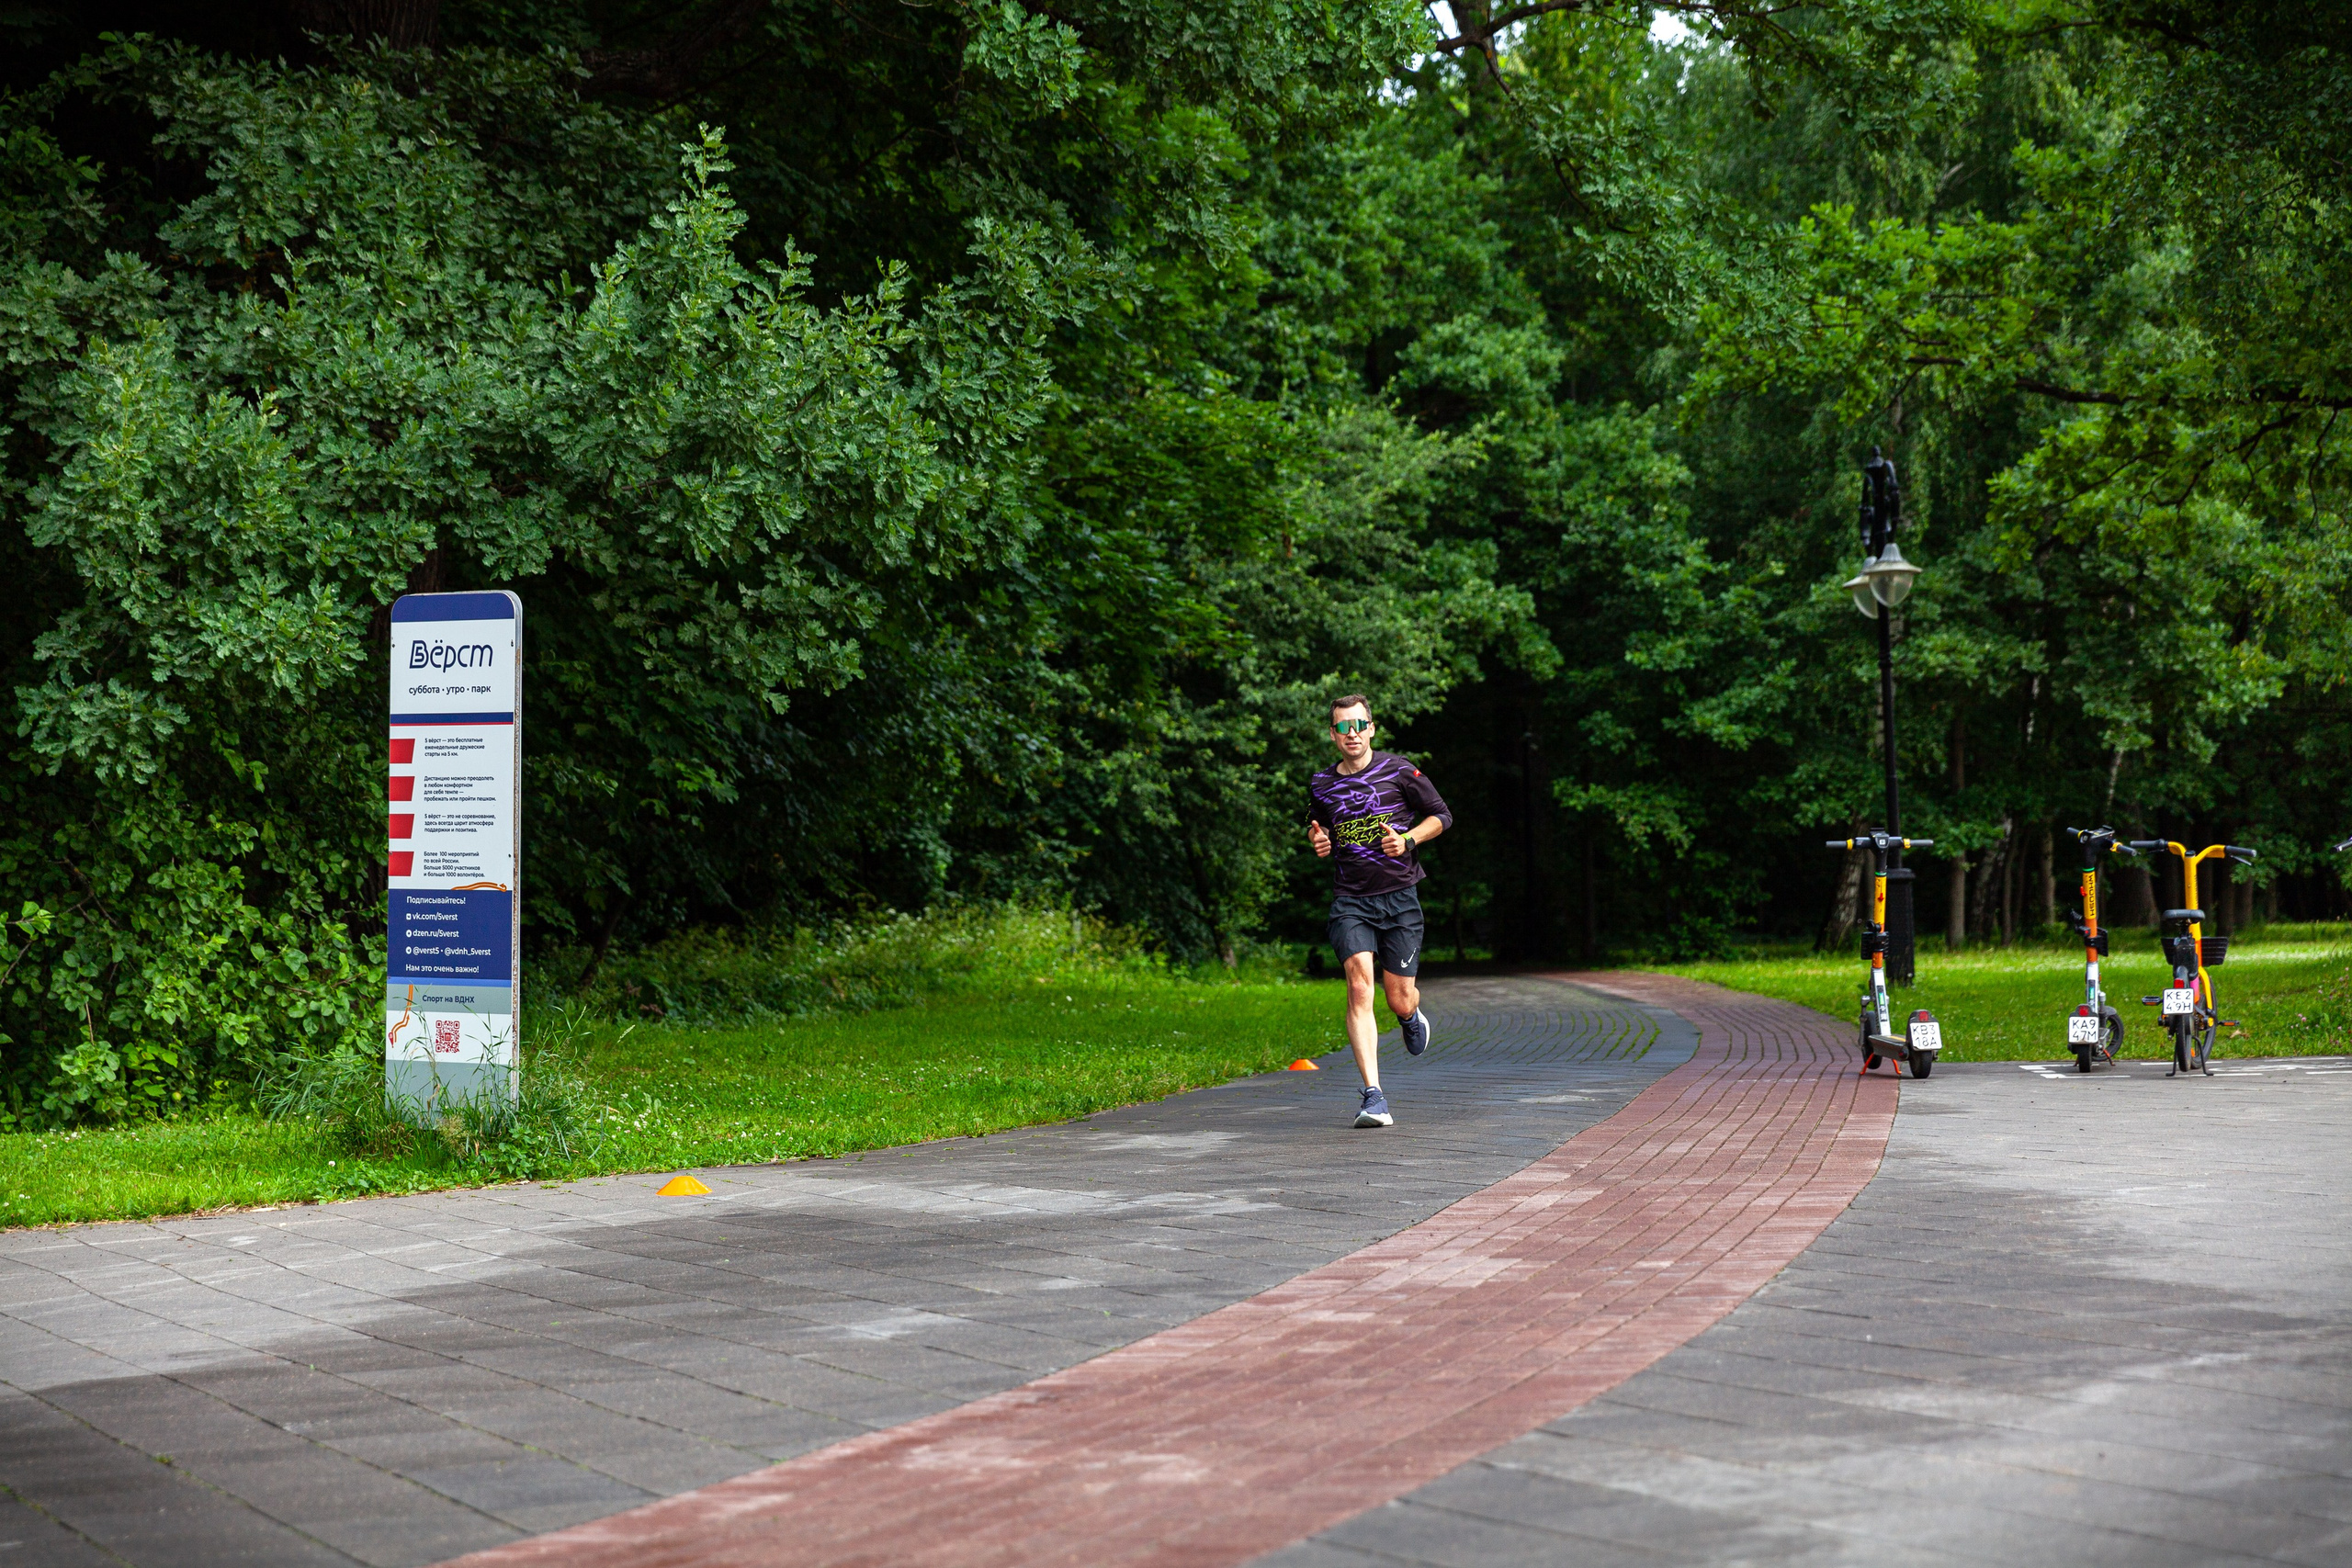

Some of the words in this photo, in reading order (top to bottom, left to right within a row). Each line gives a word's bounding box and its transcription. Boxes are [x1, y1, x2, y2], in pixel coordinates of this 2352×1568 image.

[409, 685, 440, 695] суббота
[446, 685, 465, 695] утро
[471, 685, 491, 694] парк
[406, 896, 466, 905] Подписывайтесь!
[412, 912, 458, 921] vk.com/5verst
[413, 929, 459, 937] dzen.ru/5verst
[413, 946, 439, 955] @verst5
[444, 947, 491, 956] @vdnh_5verst
[422, 995, 443, 1003] Спорт
